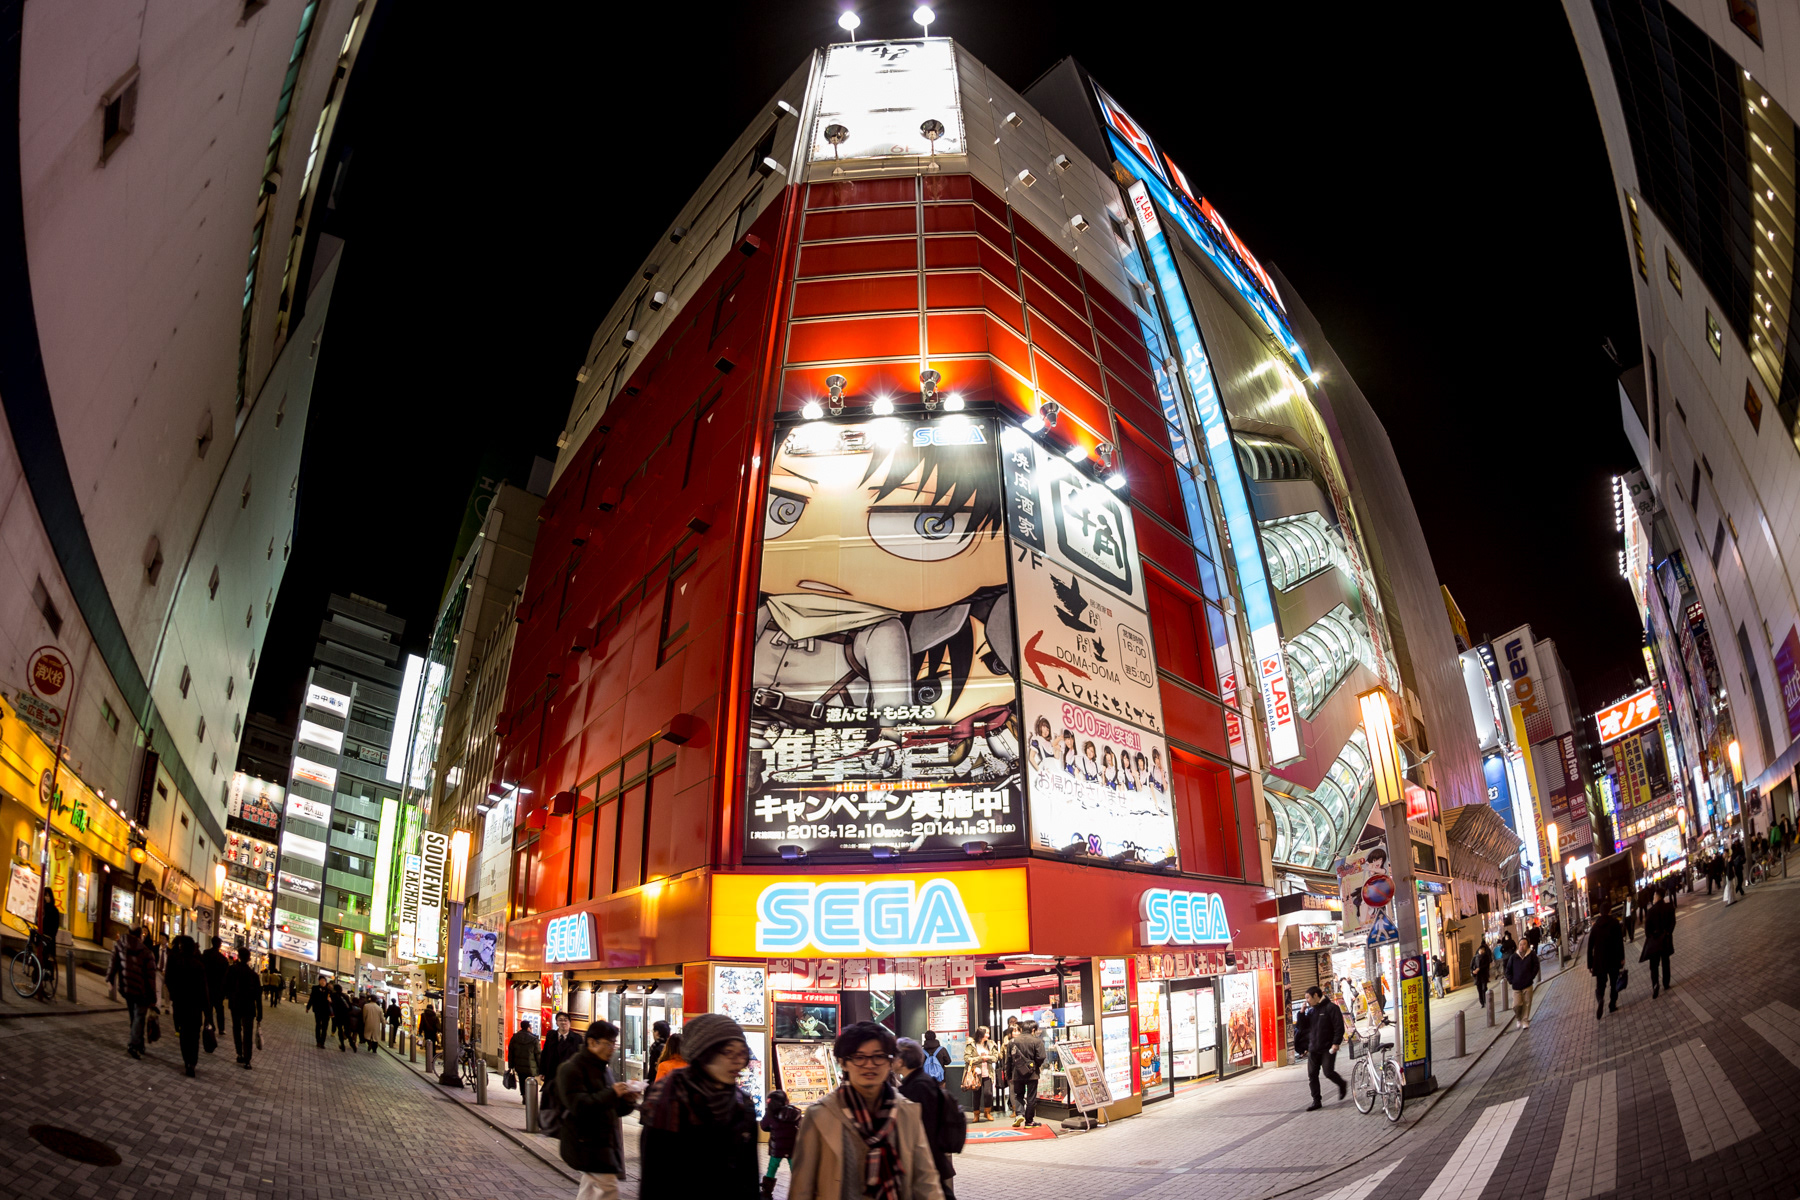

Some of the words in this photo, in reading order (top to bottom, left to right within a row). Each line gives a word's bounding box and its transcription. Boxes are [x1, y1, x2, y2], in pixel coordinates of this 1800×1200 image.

[1140, 200, 1155, 223] LABI
[1163, 152, 1287, 315] LABI
[913, 427, 988, 447] SEA
[1014, 541, 1043, 570] 7F
[1057, 646, 1120, 685] DOMA-DOMA
[1122, 639, 1147, 659] 16:00
[35, 662, 63, 688] 消火栓
[1125, 664, 1151, 684] 翌5:00
[1057, 674, 1160, 733] 入口はこちらです。
[1263, 683, 1276, 732] AKIHABARA
[1271, 677, 1291, 726] LABI
[1657, 694, 1667, 717] DUTY
[1662, 718, 1672, 740] FREE
[1062, 702, 1142, 752] 300万人突破!!
[1563, 735, 1574, 759] Duty
[762, 724, 1011, 783] 進撃の巨人
[1567, 757, 1579, 782] Free
[755, 788, 1011, 824] キャンペーン実施中!
[836, 782, 873, 792] attack
[880, 782, 895, 791] on
[900, 781, 931, 790] titan
[1672, 765, 1685, 807] TAKARA
[54, 838, 66, 912] カレーライス
[421, 834, 445, 908] SOUVENIR
[402, 869, 420, 926] EXCHANGE
[756, 878, 981, 953] SEGA
[1142, 888, 1231, 944] SEGA
[545, 911, 593, 963] SEGA
[1407, 984, 1420, 1058] 路上喫煙禁止です。
